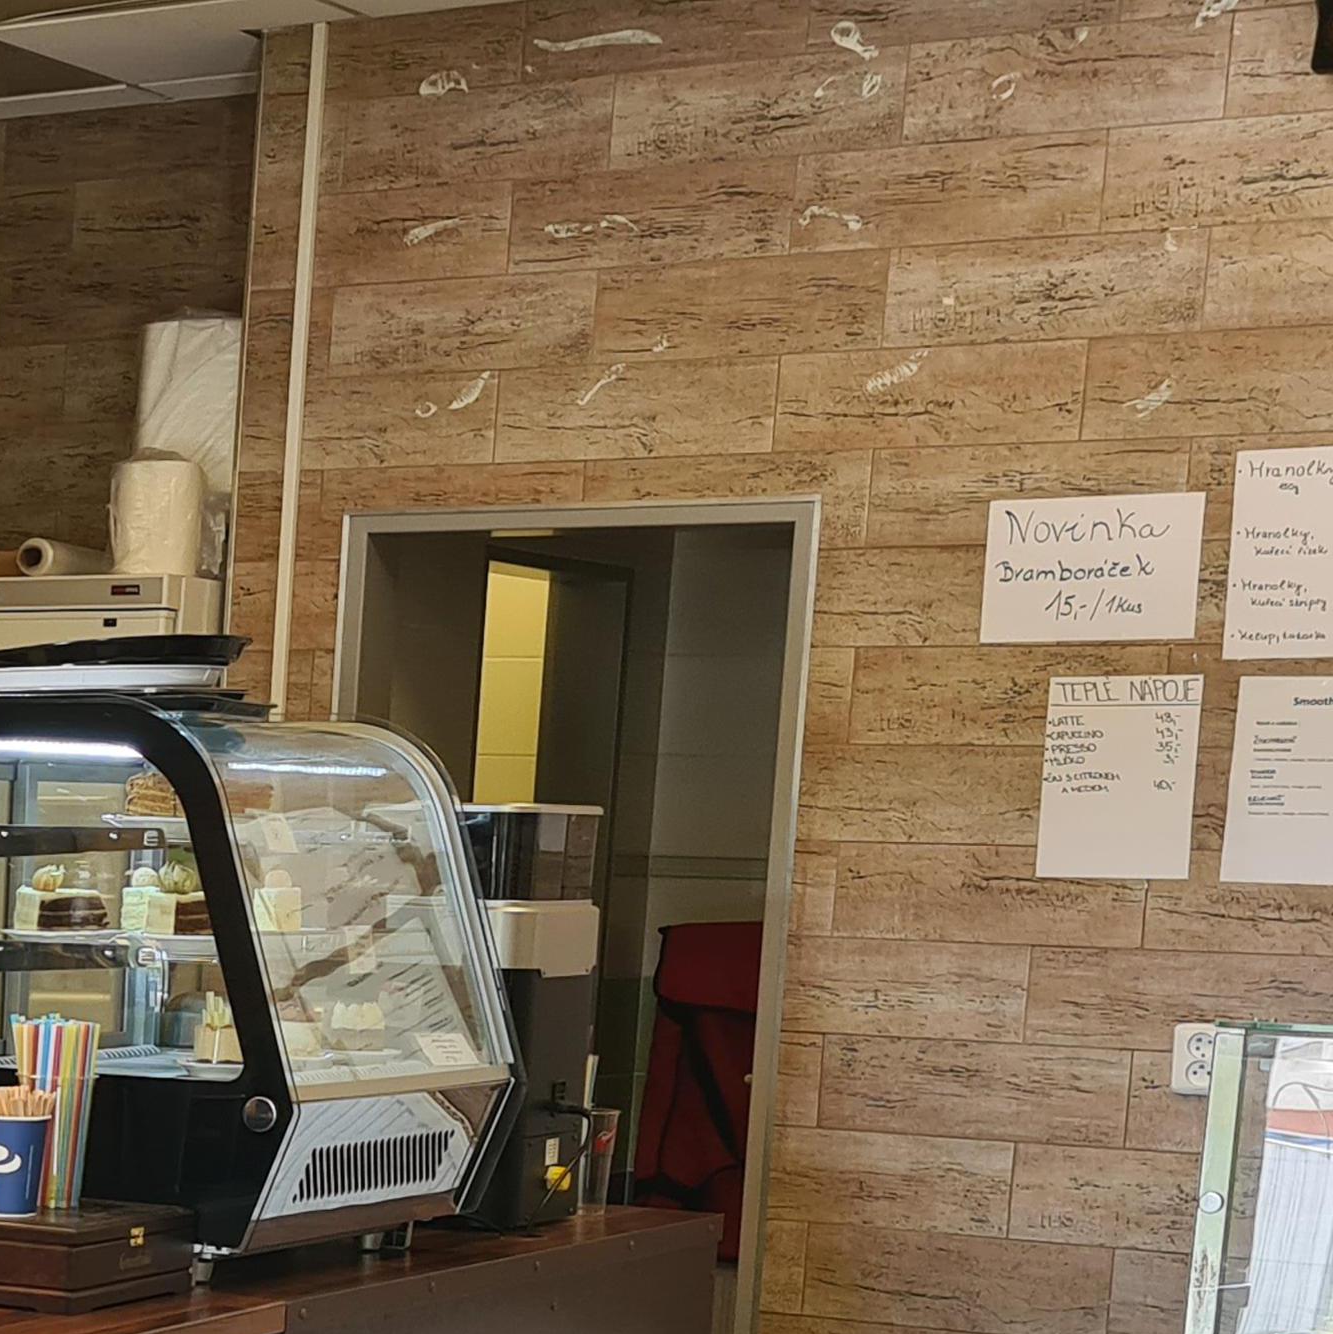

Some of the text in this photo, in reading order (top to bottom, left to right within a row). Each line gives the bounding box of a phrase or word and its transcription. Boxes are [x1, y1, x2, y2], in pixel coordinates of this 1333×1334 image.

[995, 554, 1155, 582] Bramboráček
[1054, 676, 1200, 702] TEPLÉ NÁPOJE
[1051, 715, 1084, 726] LATTE
